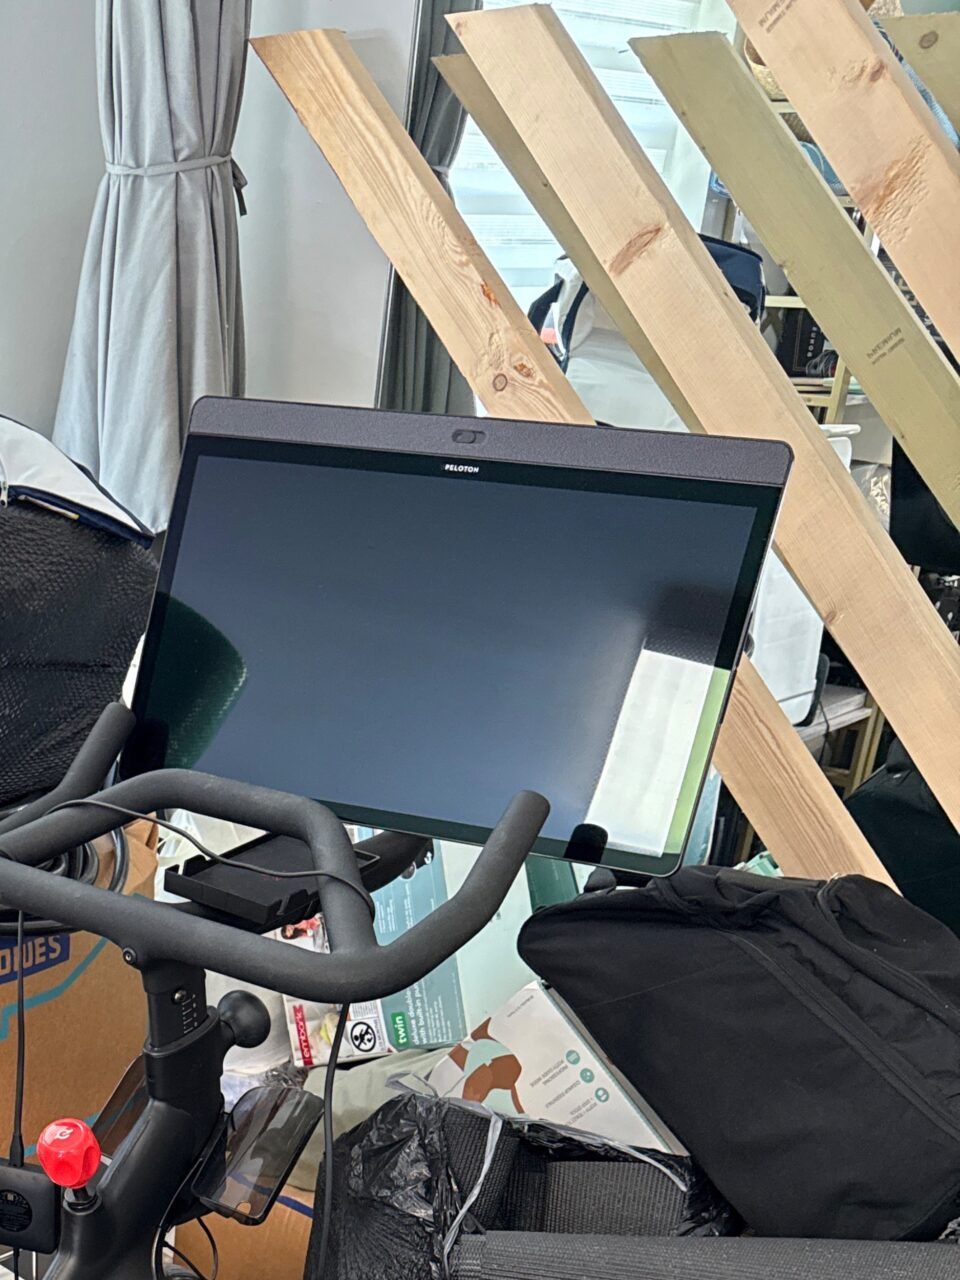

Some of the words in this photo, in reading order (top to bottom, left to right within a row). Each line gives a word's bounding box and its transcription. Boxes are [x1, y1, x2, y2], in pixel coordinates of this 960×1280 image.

[444, 463, 479, 473] PELOTON
[296, 1010, 311, 1059] embark
[394, 1015, 407, 1044] twin
